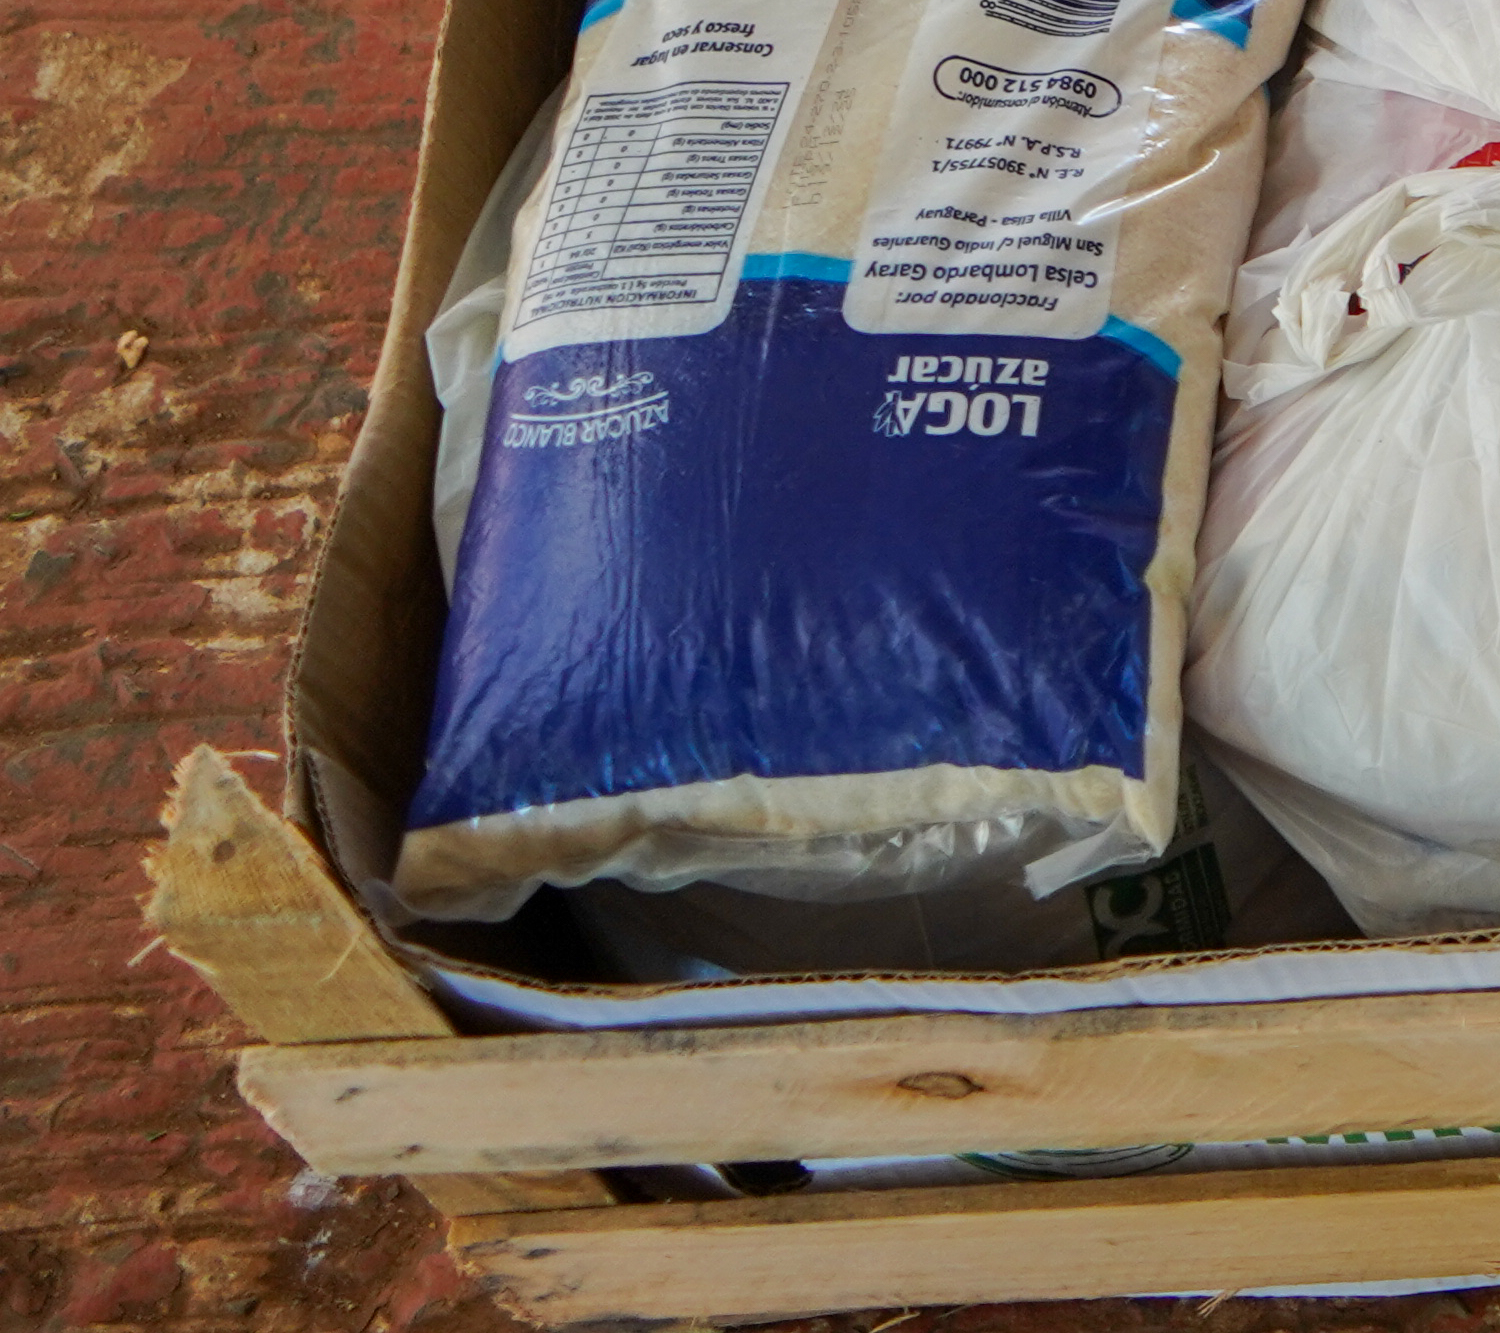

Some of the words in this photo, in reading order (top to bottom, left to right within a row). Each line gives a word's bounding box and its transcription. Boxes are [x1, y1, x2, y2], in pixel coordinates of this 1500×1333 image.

[662, 25, 689, 42] seco
[692, 20, 703, 32] y
[704, 20, 754, 37] fresco
[630, 49, 668, 68] lugar
[671, 44, 688, 57] en
[690, 41, 774, 57] Conservar
[958, 65, 998, 89] 000
[1002, 77, 1041, 92] 512
[1046, 75, 1096, 96] 0984
[956, 91, 1027, 107] consumidor:
[1041, 94, 1091, 116] Atención
[945, 136, 992, 149] 79971
[931, 157, 1026, 176] 39057755/1
[915, 205, 986, 226] Paraguay
[1001, 214, 1034, 227] Elisa
[1039, 208, 1071, 222] Villa
[996, 237, 1013, 252] c/
[1017, 230, 1071, 252] Miguel
[1075, 238, 1103, 255] San
[863, 259, 926, 281] Garay
[931, 264, 1038, 286] Lombardo
[1043, 265, 1098, 289] Celsa
[894, 289, 936, 305] por:
[941, 291, 1057, 311] Fraccionado
[885, 353, 1049, 390] azúcar
[880, 389, 1040, 437] LOGA
[502, 419, 576, 444] BLANCO
